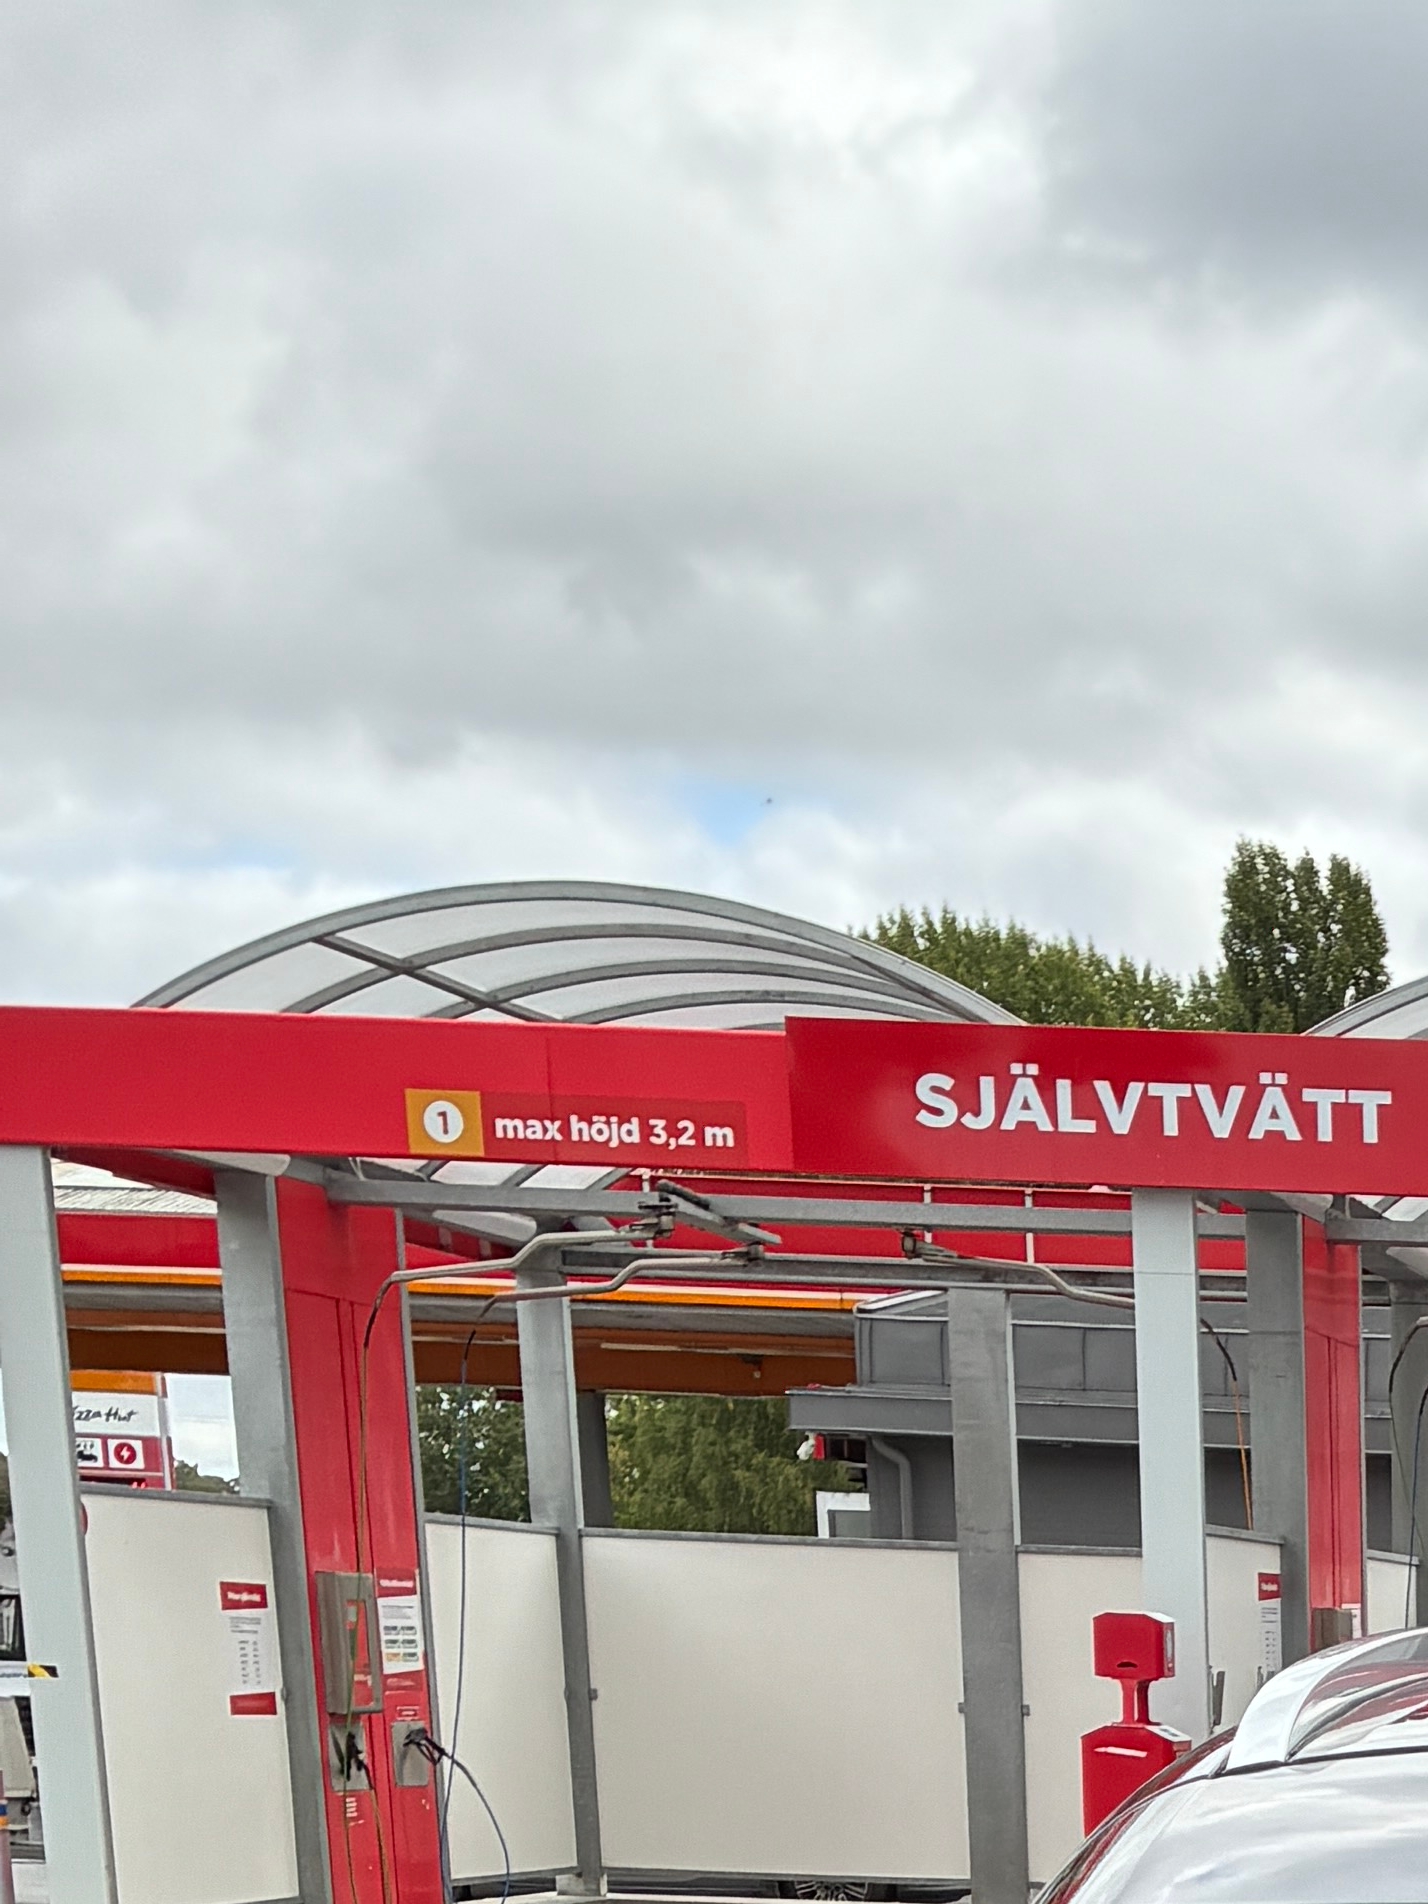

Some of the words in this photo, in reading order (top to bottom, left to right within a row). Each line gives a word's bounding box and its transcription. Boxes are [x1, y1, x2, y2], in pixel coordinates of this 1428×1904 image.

[915, 1063, 1392, 1143] SJÄLVTVÄTT
[437, 1110, 450, 1135] 1
[494, 1116, 563, 1141] max
[569, 1114, 641, 1148] höjd
[648, 1118, 696, 1150] 3,2
[704, 1125, 735, 1147] m
[105, 1406, 138, 1422] Hut
